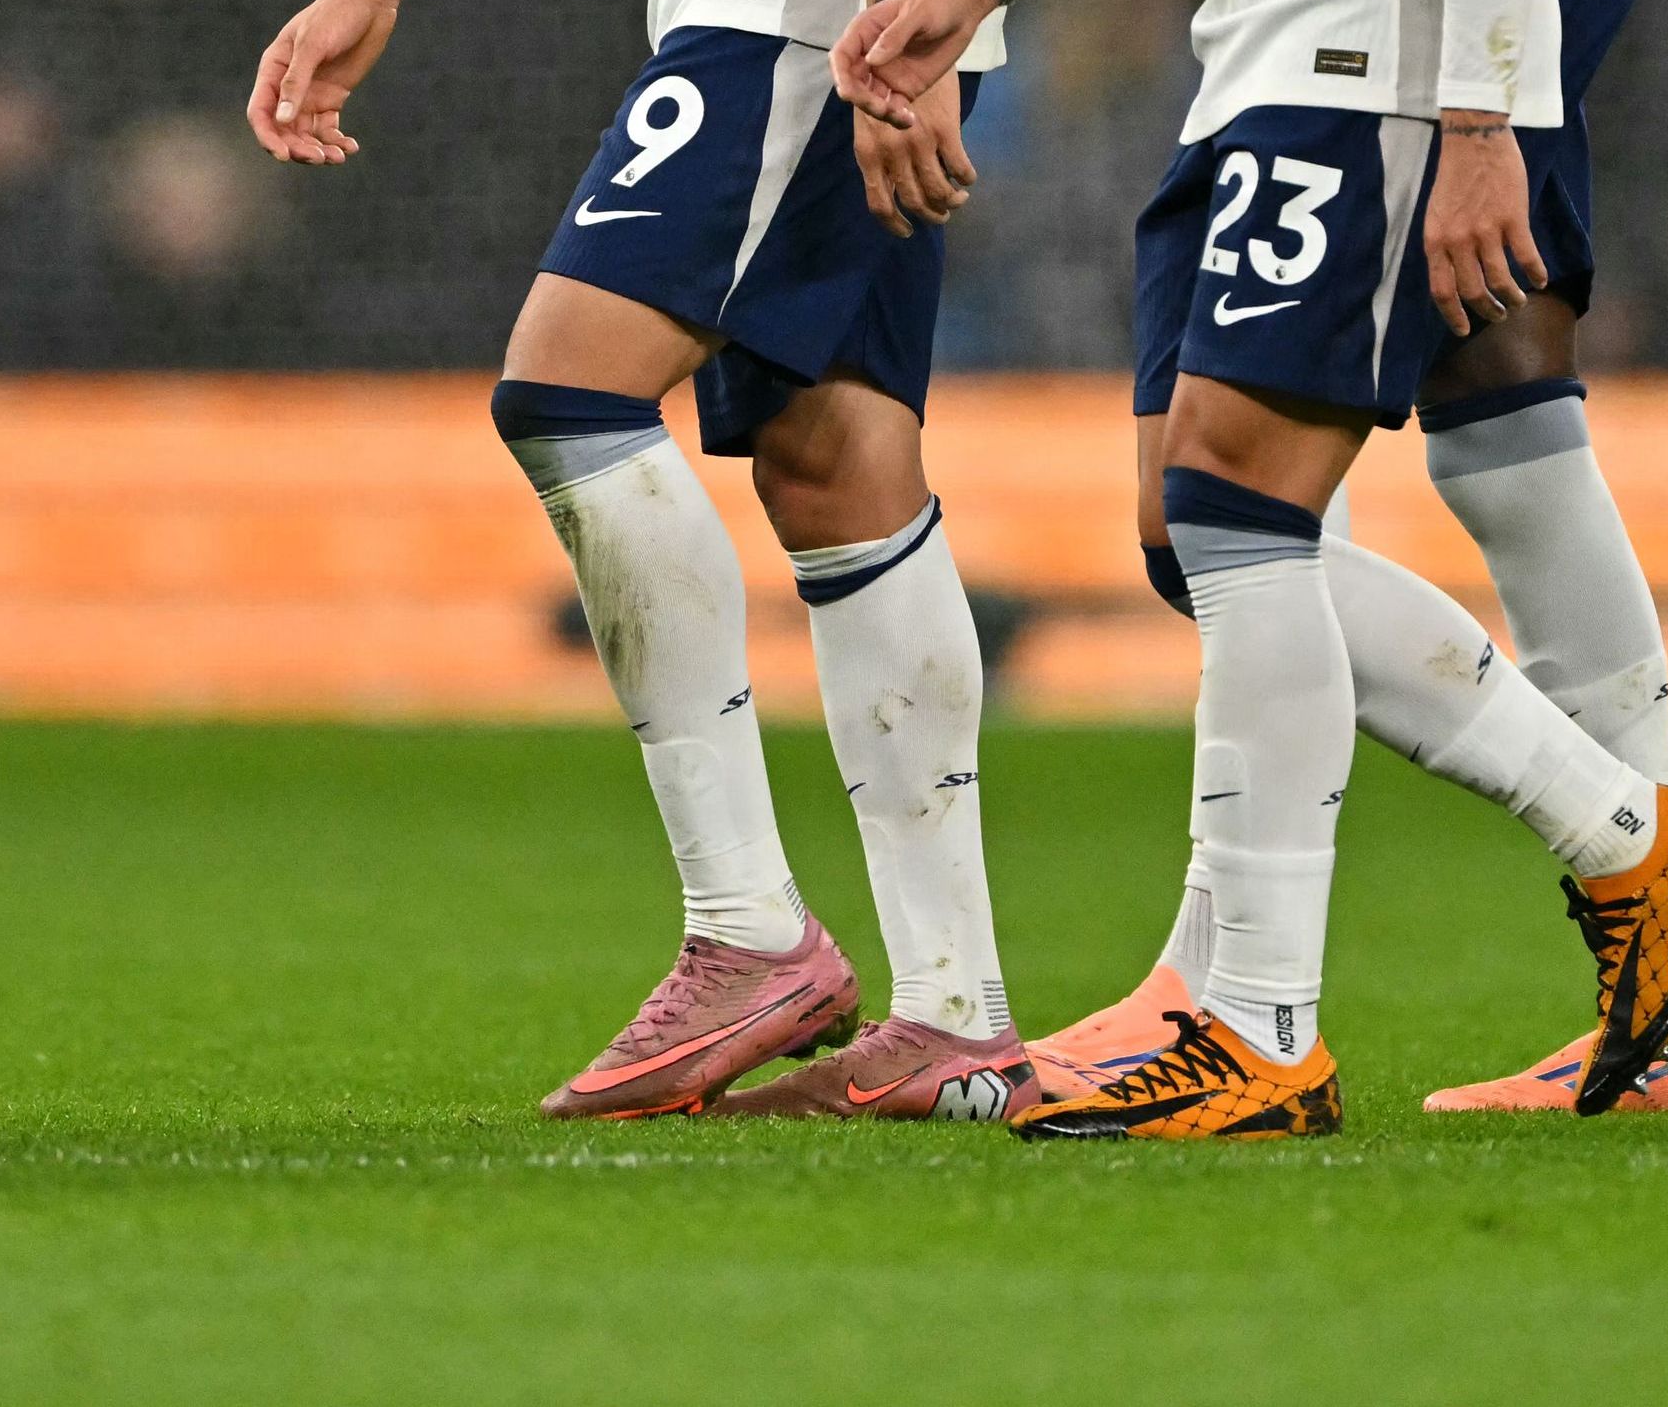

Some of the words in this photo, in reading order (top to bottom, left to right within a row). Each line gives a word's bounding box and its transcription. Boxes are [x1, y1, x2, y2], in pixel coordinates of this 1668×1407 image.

[610, 75, 706, 189] 9
[1200, 150, 1344, 287] 23
[1275, 1004, 1295, 1056] ESIGN
